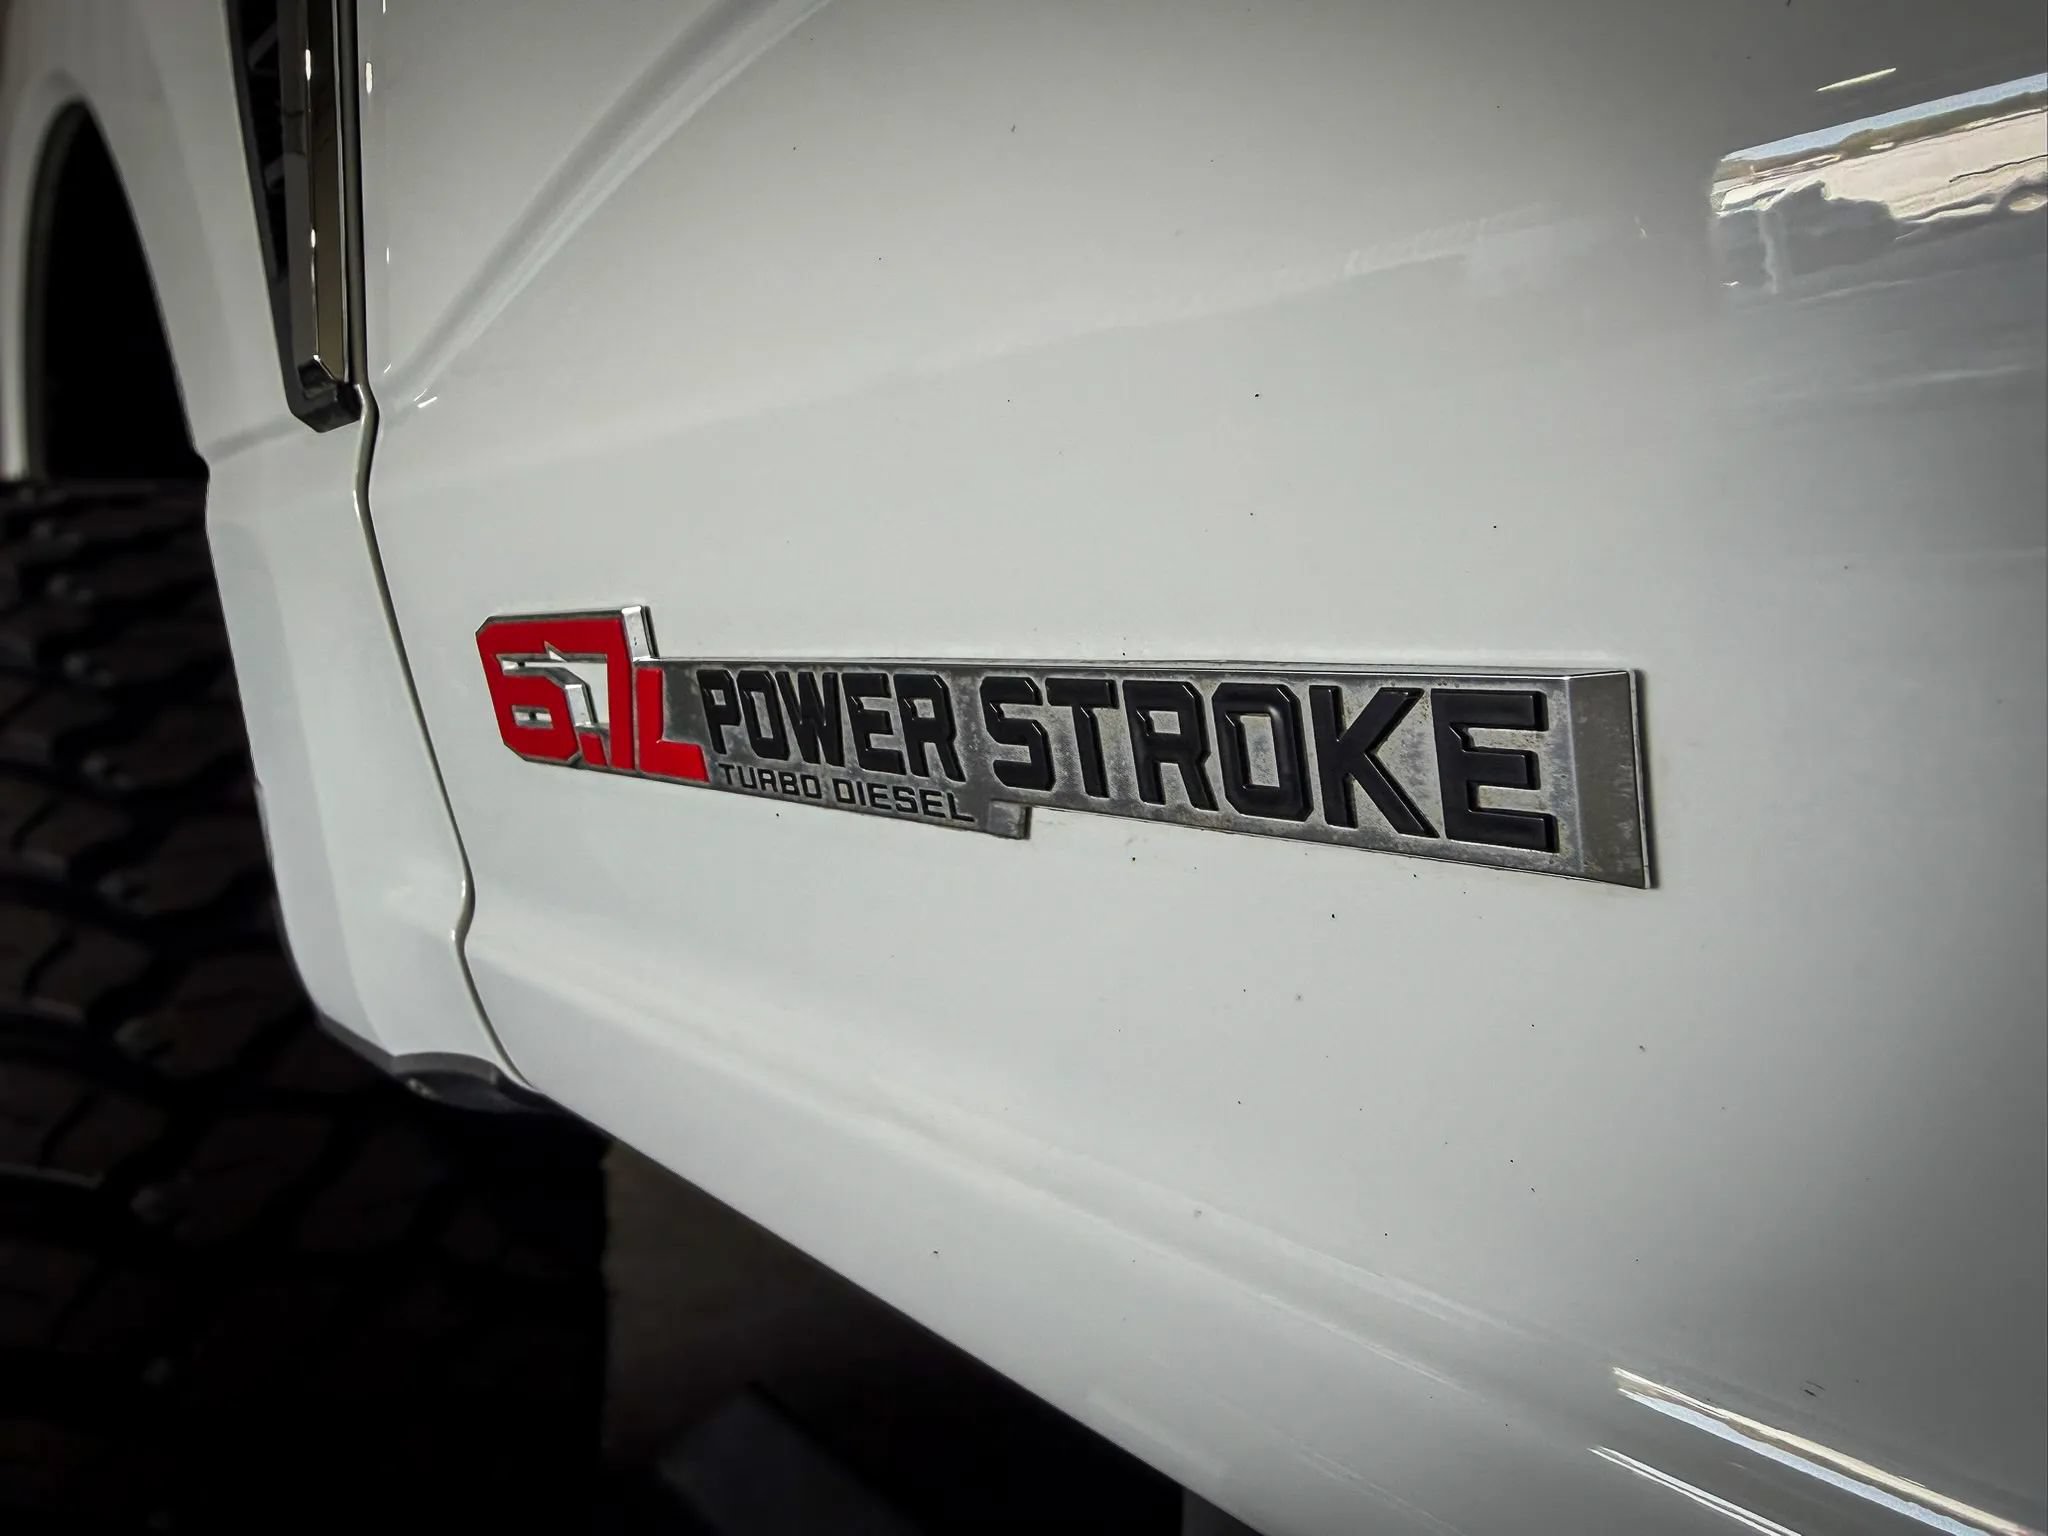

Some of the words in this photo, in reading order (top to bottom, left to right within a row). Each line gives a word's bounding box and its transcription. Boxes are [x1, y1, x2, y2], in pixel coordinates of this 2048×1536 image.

[475, 616, 710, 783] 6.7L
[697, 669, 967, 782] POWER
[979, 676, 1560, 854] STROKE
[718, 763, 823, 800] TURBO
[838, 779, 975, 823] DIESEL
